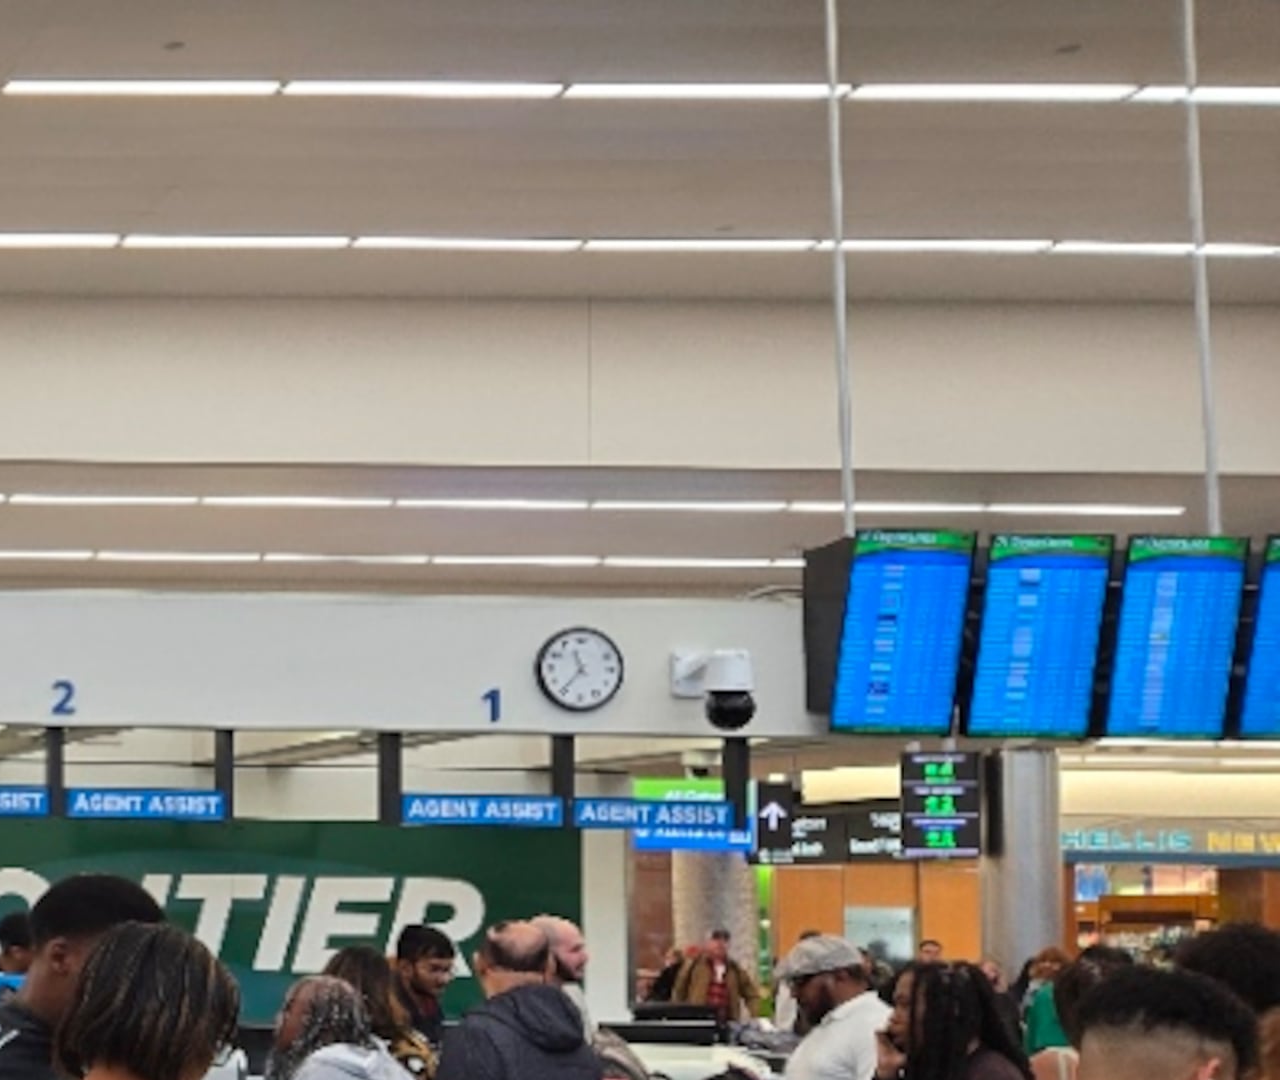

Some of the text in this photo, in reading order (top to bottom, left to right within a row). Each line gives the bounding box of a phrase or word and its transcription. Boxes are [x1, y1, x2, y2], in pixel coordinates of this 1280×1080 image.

[51, 681, 76, 715] 2
[481, 689, 501, 722] 1
[74, 794, 221, 815] AGENT ASSIST
[409, 801, 558, 820] AGENT ASSIST
[580, 805, 730, 824] AGENT ASSIST
